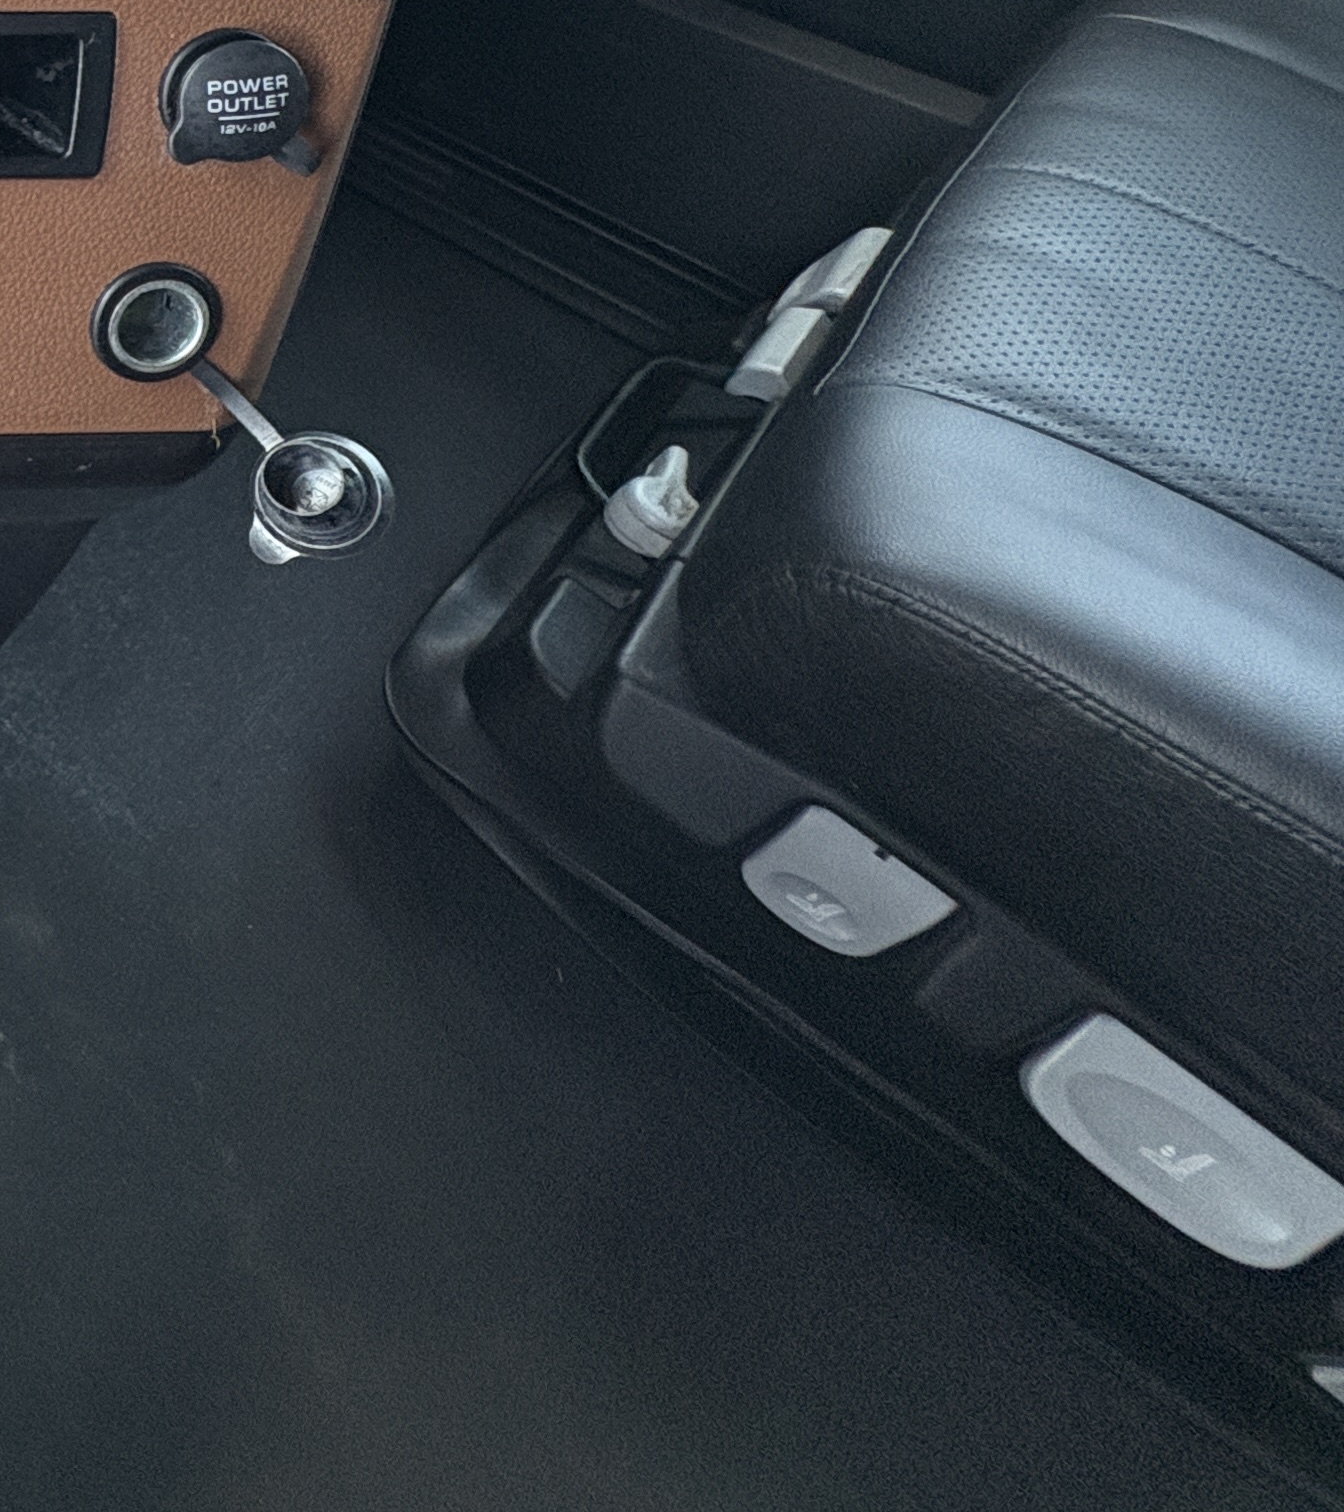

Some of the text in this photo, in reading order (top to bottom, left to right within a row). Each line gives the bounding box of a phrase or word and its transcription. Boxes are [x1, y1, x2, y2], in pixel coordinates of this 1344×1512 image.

[207, 74, 289, 95] POWER
[207, 92, 289, 113] OUTLET
[219, 120, 278, 135] 12V-10A
